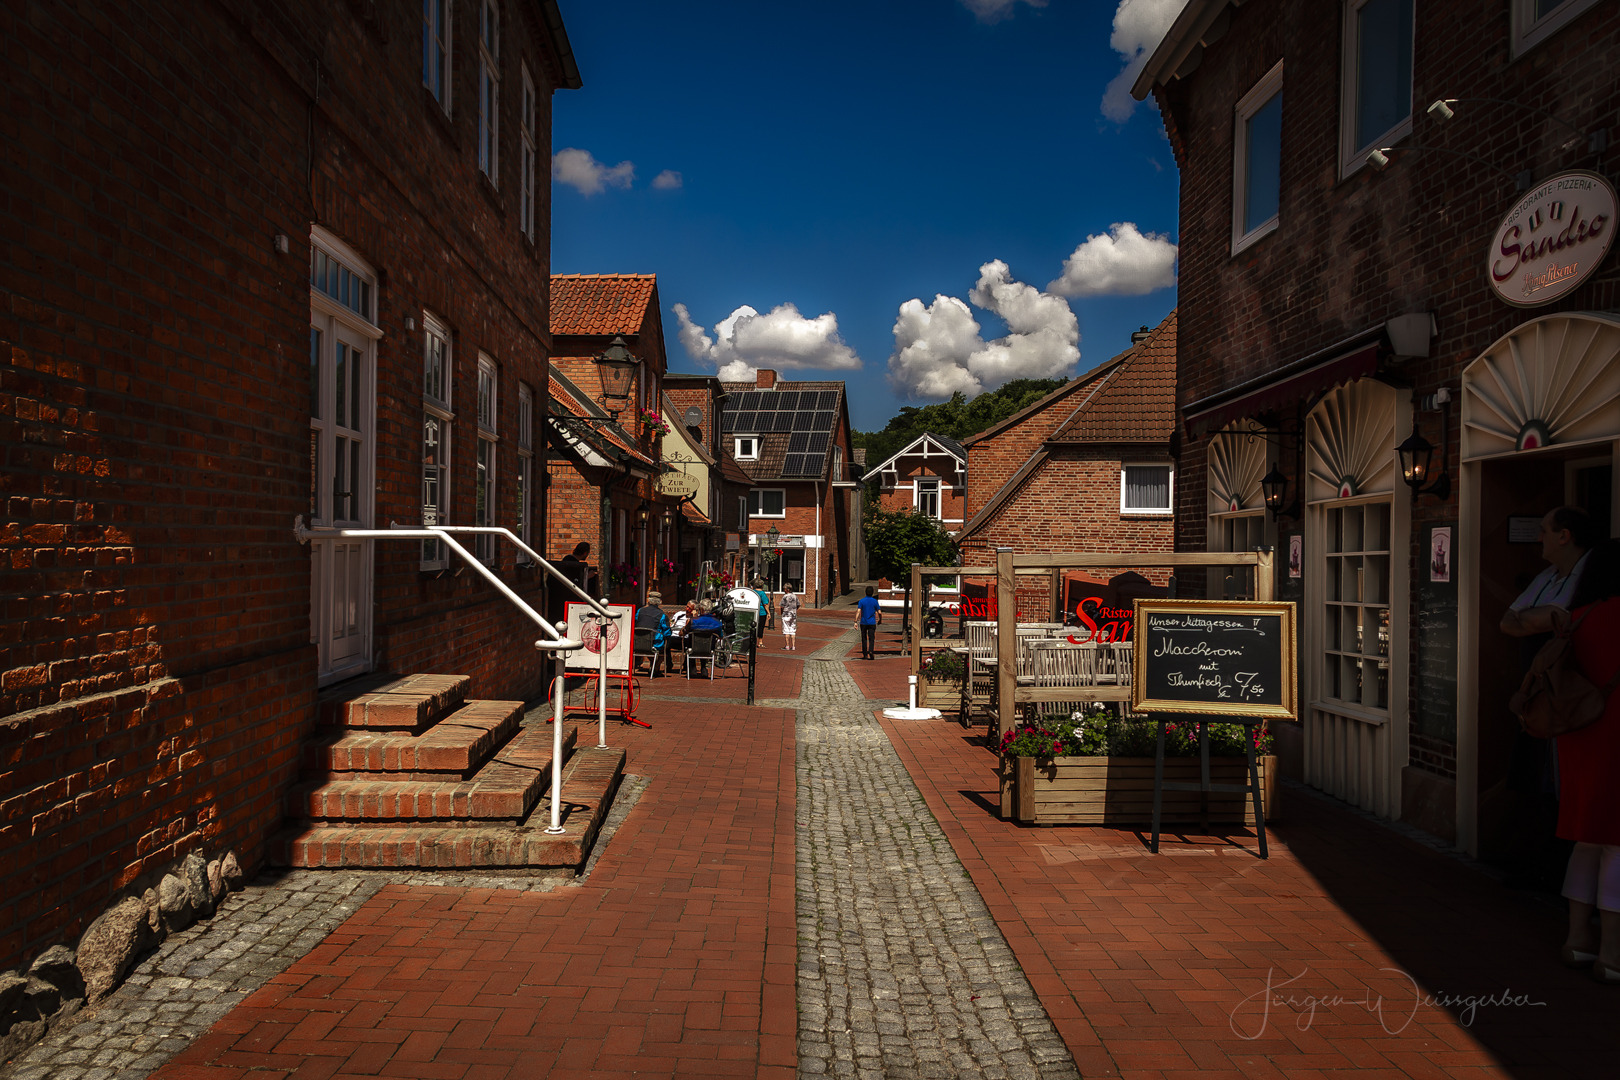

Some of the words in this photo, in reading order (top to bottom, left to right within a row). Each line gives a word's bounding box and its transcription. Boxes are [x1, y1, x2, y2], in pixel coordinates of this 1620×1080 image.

[1508, 185, 1553, 225] RISTORANTE
[1556, 179, 1593, 192] PIZZERIA
[1492, 205, 1606, 281] Sandro
[1148, 615, 1180, 627] Unser
[1181, 615, 1245, 633] Mittagessen
[1153, 636, 1245, 657] Maccheroni
[1198, 658, 1220, 671] mit
[1167, 671, 1222, 690] Thunfisch
